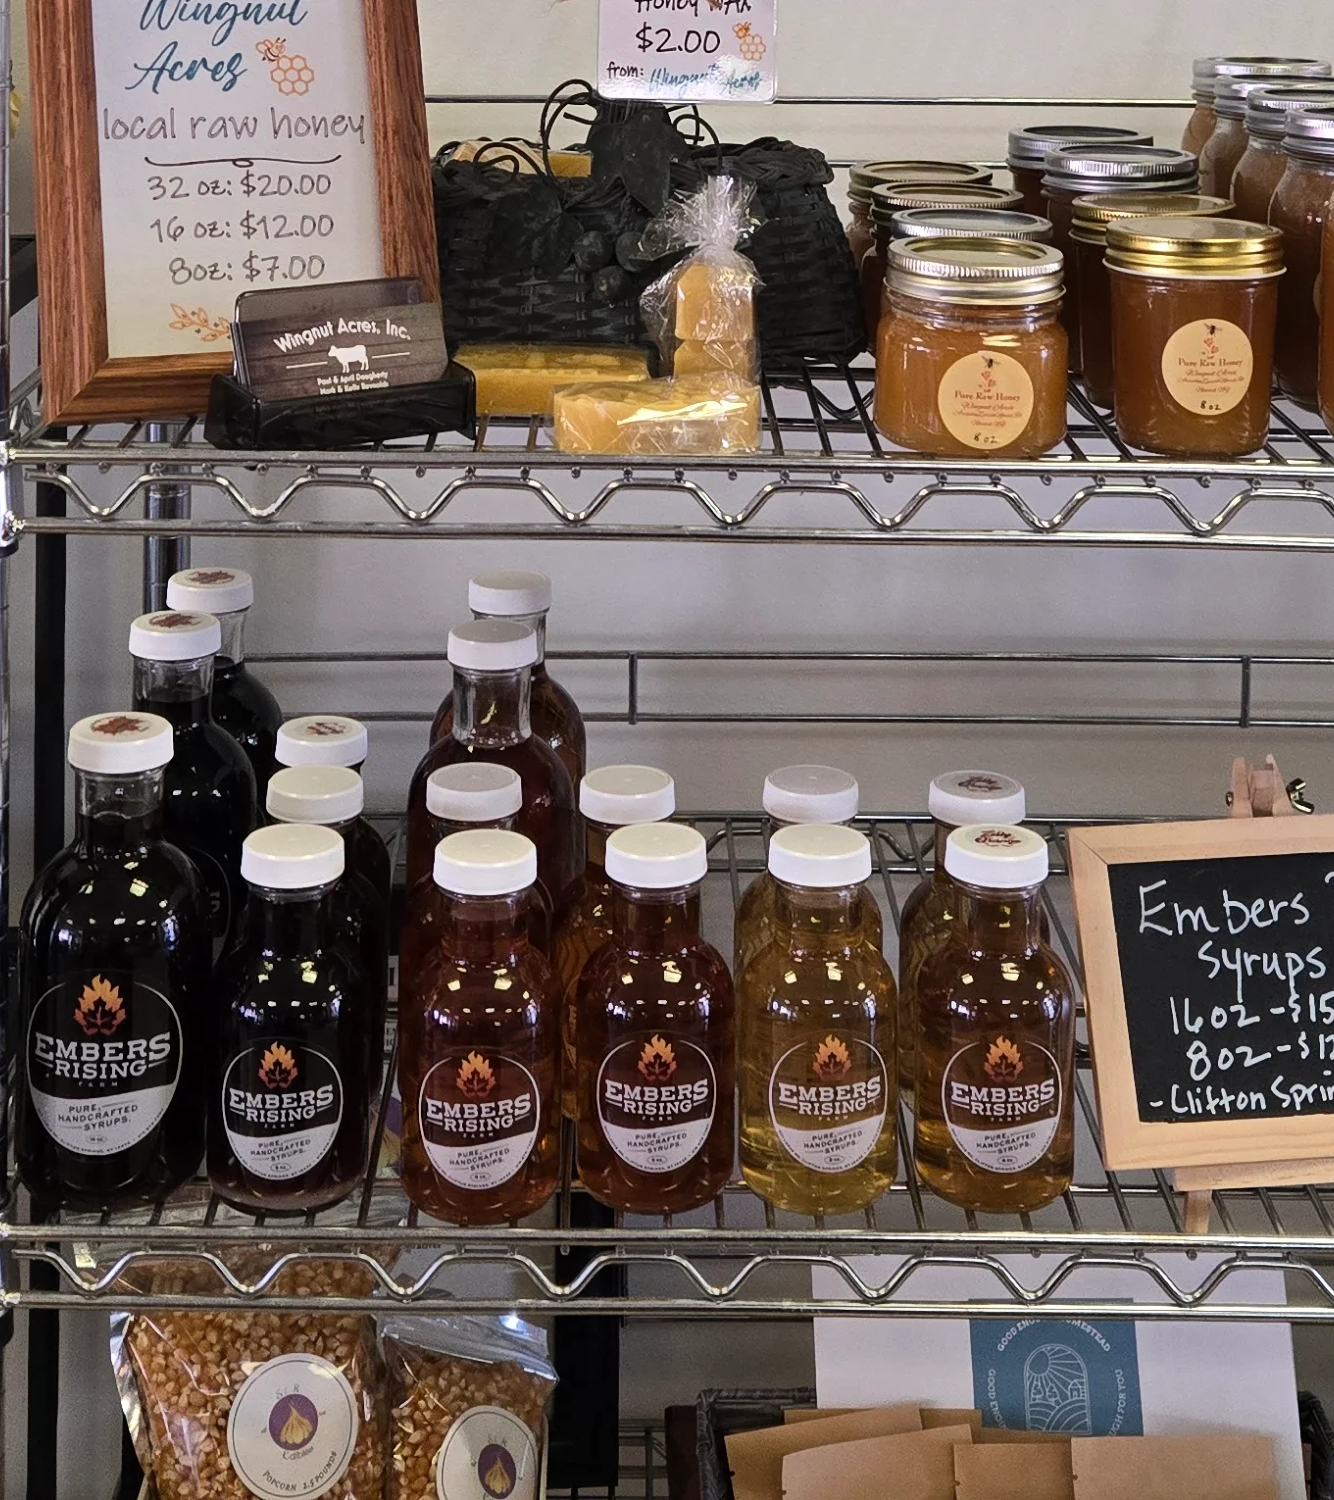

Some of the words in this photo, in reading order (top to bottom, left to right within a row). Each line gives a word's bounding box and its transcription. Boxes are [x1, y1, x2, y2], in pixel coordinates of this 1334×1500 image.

[635, 22, 721, 54] $2.00
[124, 40, 249, 94] Acres
[607, 61, 644, 80] from:
[103, 107, 177, 141] local
[189, 114, 257, 140] raw
[269, 107, 365, 145] honey
[147, 176, 190, 201] 32
[197, 178, 233, 198] oz:
[241, 170, 332, 198] $20.00
[149, 220, 185, 244] 16
[193, 220, 233, 240] oz:
[243, 210, 335, 240] $12.00
[244, 251, 327, 282] $7.00
[273, 320, 334, 353] Wingnut
[386, 318, 411, 340] Inc.
[1138, 878, 1309, 936] Embers
[35, 1030, 171, 1063] EMBERS
[54, 1058, 147, 1081] RISING
[229, 1084, 333, 1112] EMBERS
[605, 1079, 709, 1101] EMBERS
[778, 1076, 881, 1102] EMBERS
[951, 1079, 1054, 1103] EMBERS
[57, 1104, 139, 1123] HANDCRAFTED
[69, 1104, 101, 1114] PURE,
[245, 1106, 317, 1124] RISING
[425, 1092, 531, 1119] EMBERS
[622, 1098, 693, 1117] RISING
[798, 1097, 867, 1117] RISING
[970, 1099, 1040, 1118] RISING
[83, 1116, 131, 1131] SYRUPS.
[443, 1114, 513, 1134] RISING
